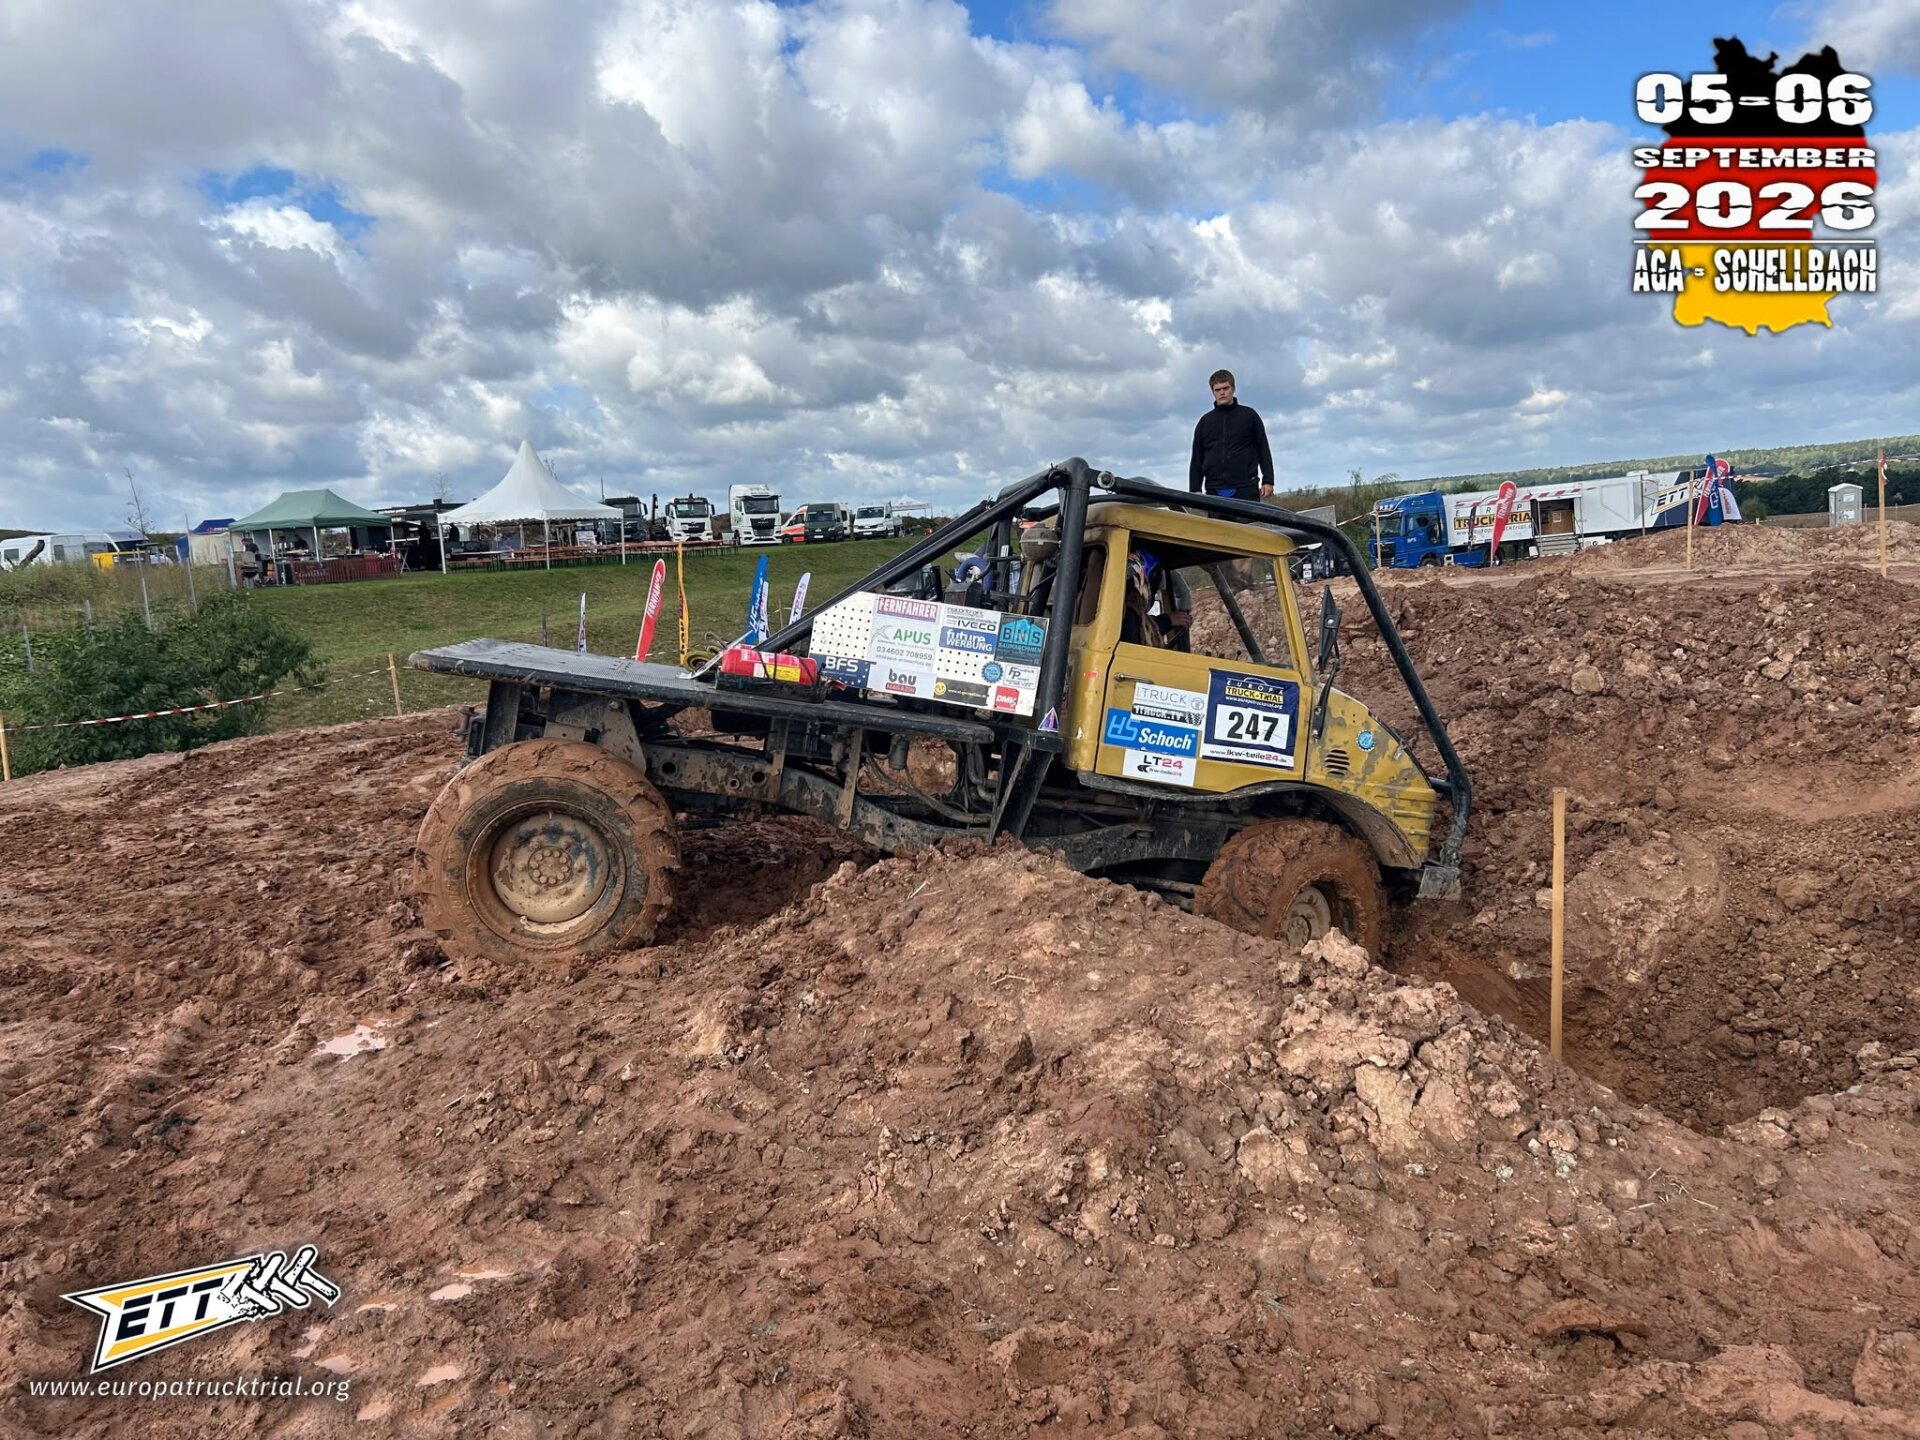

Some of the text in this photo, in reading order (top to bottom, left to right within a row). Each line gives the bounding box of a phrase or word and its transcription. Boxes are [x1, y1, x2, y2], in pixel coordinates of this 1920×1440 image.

[878, 597, 937, 618] FERNFAHRER
[957, 619, 996, 632] IVECO
[893, 628, 932, 646] APUS
[946, 629, 986, 643] future
[1003, 627, 1041, 644] BNS
[946, 638, 993, 652] WERBUNG
[825, 656, 859, 672] BFS
[888, 668, 917, 685] bau
[887, 684, 915, 693] MAGAZIN
[1226, 680, 1284, 695] EUROPA
[1142, 688, 1187, 704] TRUCK
[1227, 711, 1279, 742] 247
[1138, 728, 1192, 750] Schoch
[1143, 755, 1184, 769] LT24
